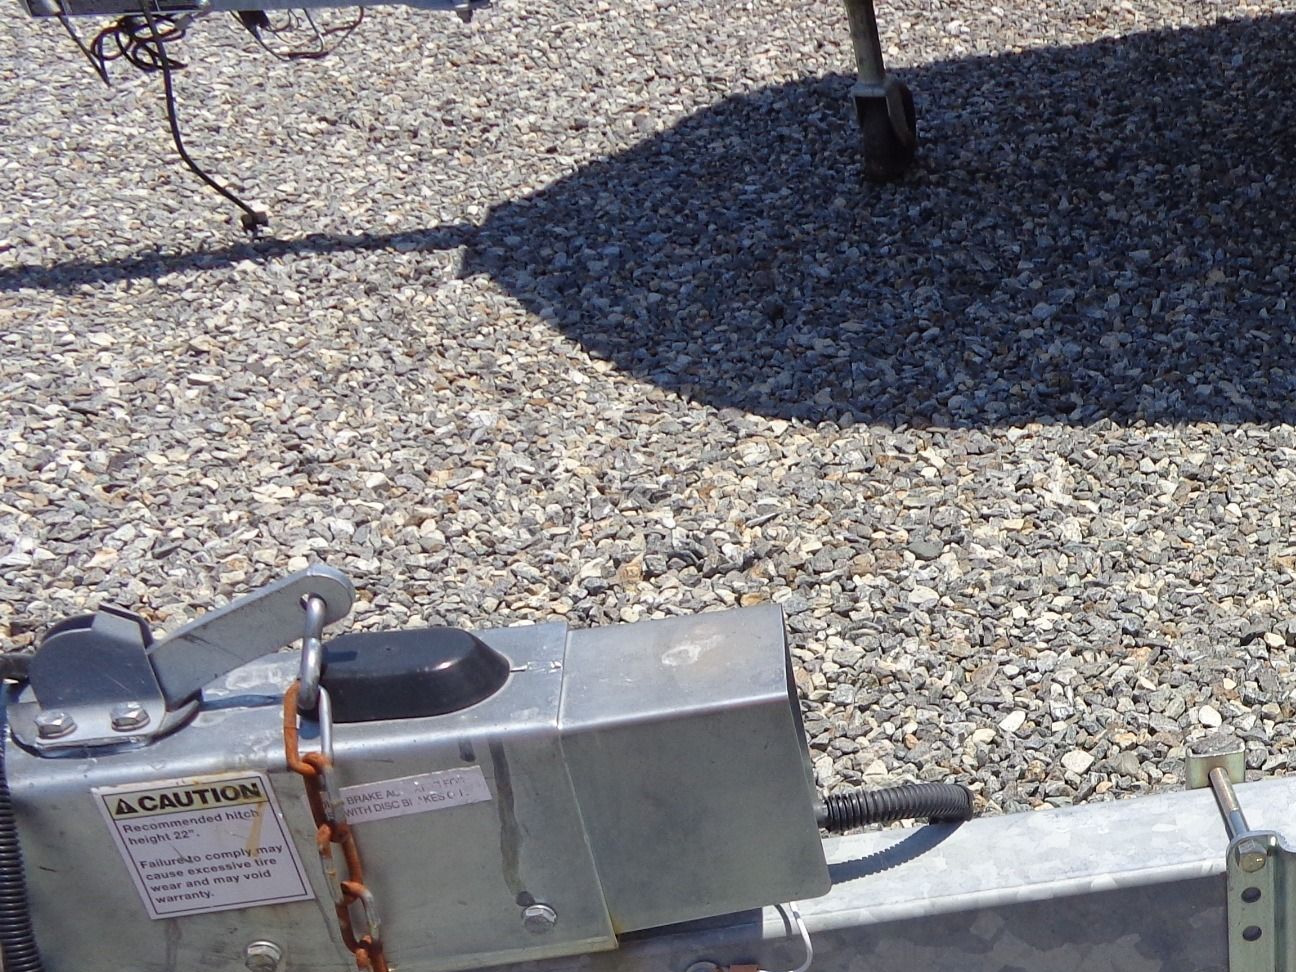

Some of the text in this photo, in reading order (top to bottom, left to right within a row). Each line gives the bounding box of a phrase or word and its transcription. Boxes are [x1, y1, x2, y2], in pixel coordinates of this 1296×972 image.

[138, 782, 262, 812] CAUTION
[346, 791, 382, 805] BRAKE
[344, 804, 372, 818] WITH
[375, 800, 399, 813] DISC
[122, 808, 259, 834] Recommended hitch
[129, 831, 171, 847] height
[140, 856, 186, 869] Failure
[205, 847, 252, 863] comply
[256, 844, 283, 856] may
[146, 856, 277, 881] cause excessive tire
[151, 869, 271, 892] wear and may void
[155, 889, 215, 904] warranty.
